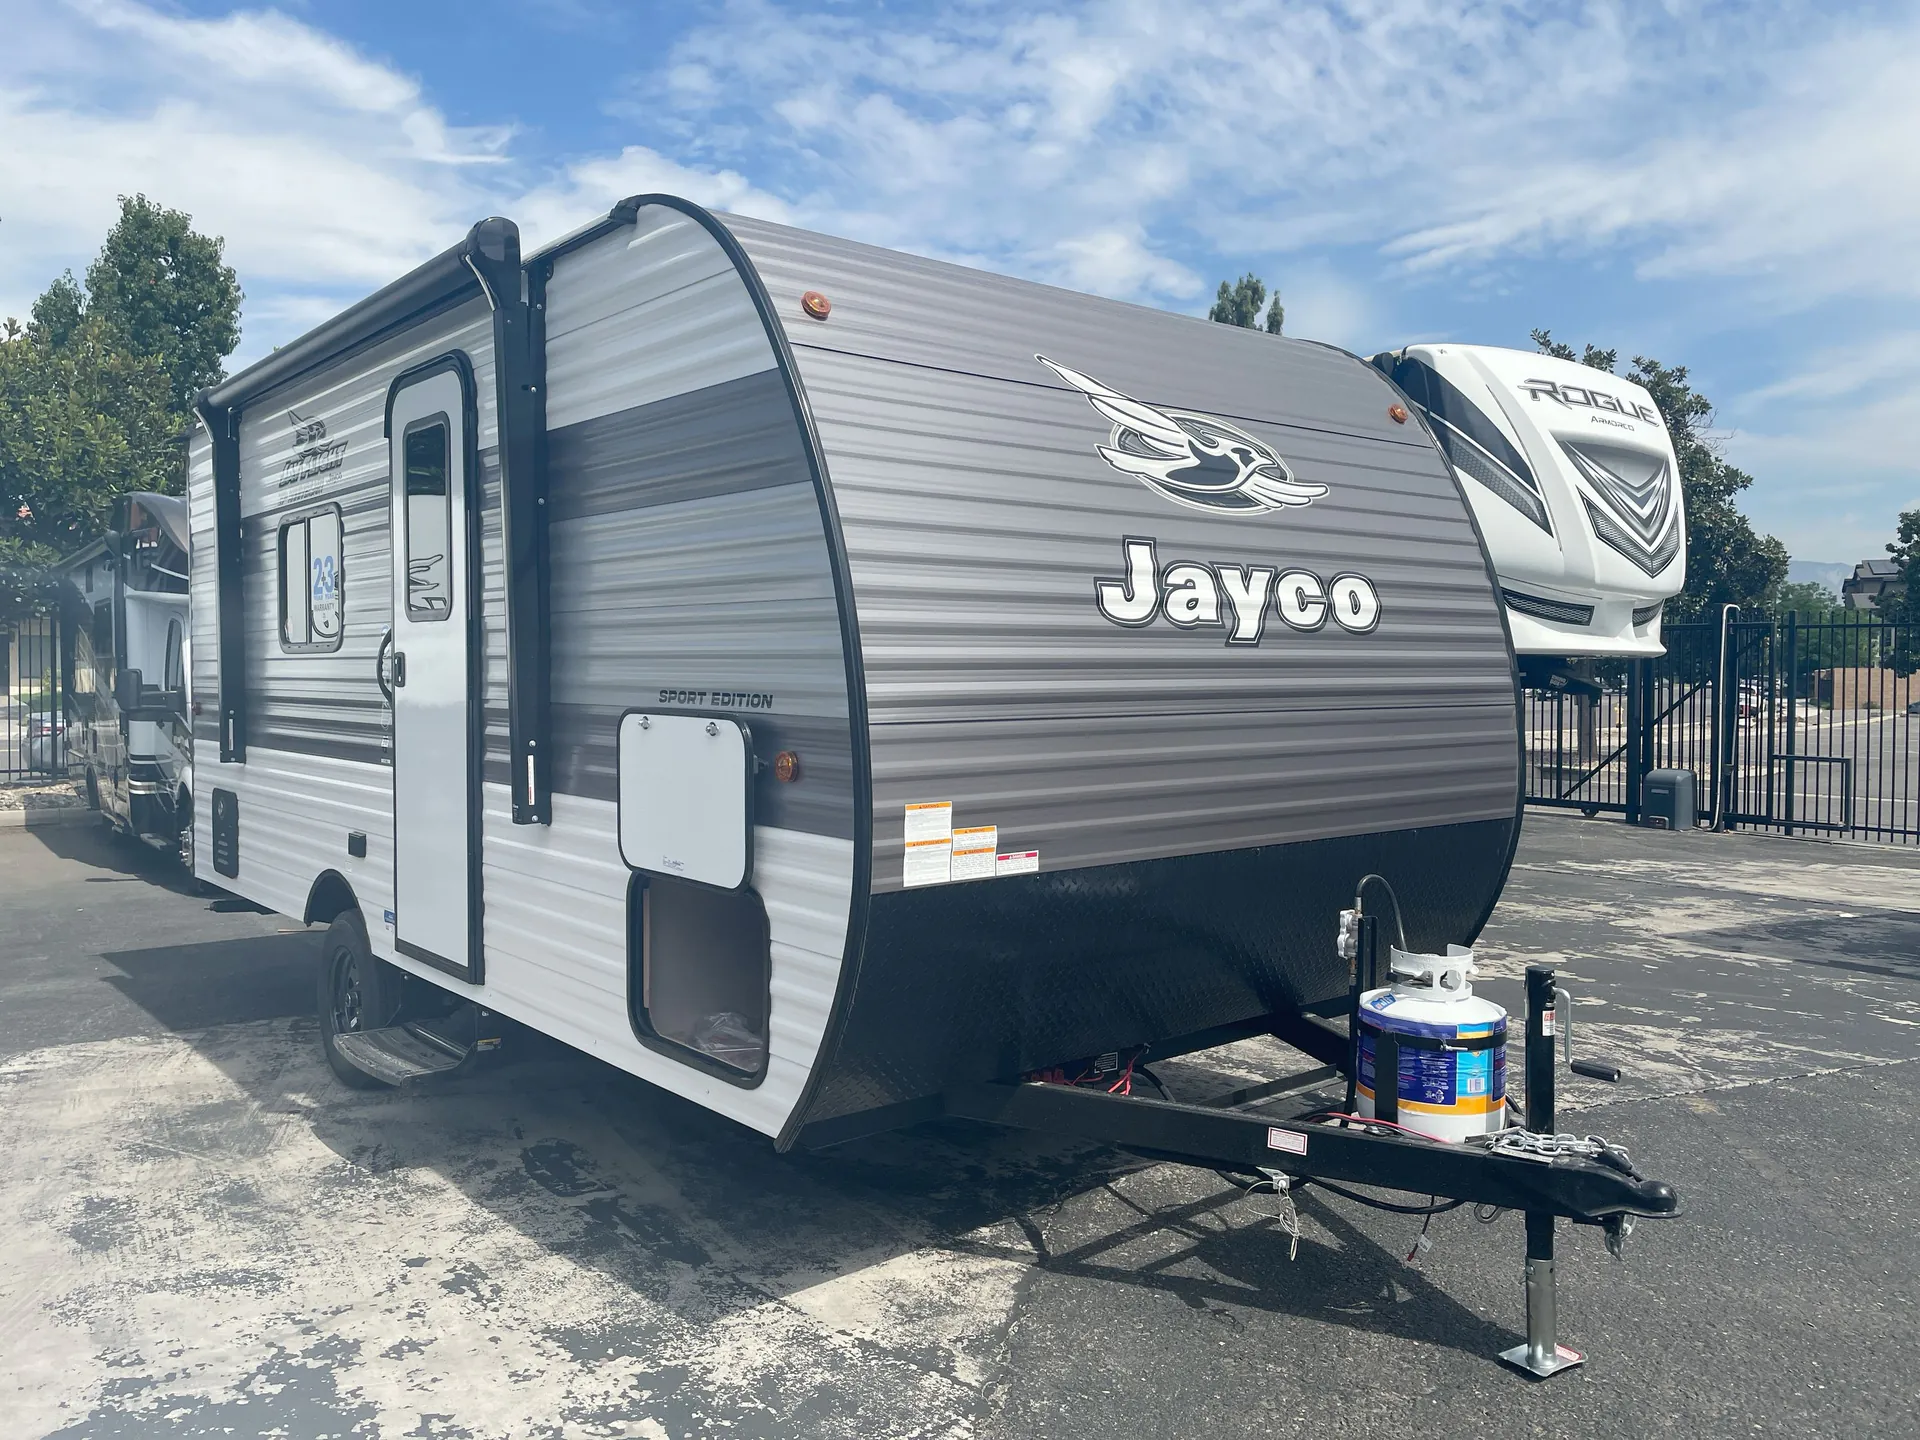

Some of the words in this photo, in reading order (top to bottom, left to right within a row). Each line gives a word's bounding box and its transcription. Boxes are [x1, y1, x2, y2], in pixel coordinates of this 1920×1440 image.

[1517, 378, 1660, 428] ROGUE
[1093, 534, 1382, 648] Jayco
[658, 689, 707, 705] SPORT
[710, 692, 774, 709] EDITION
